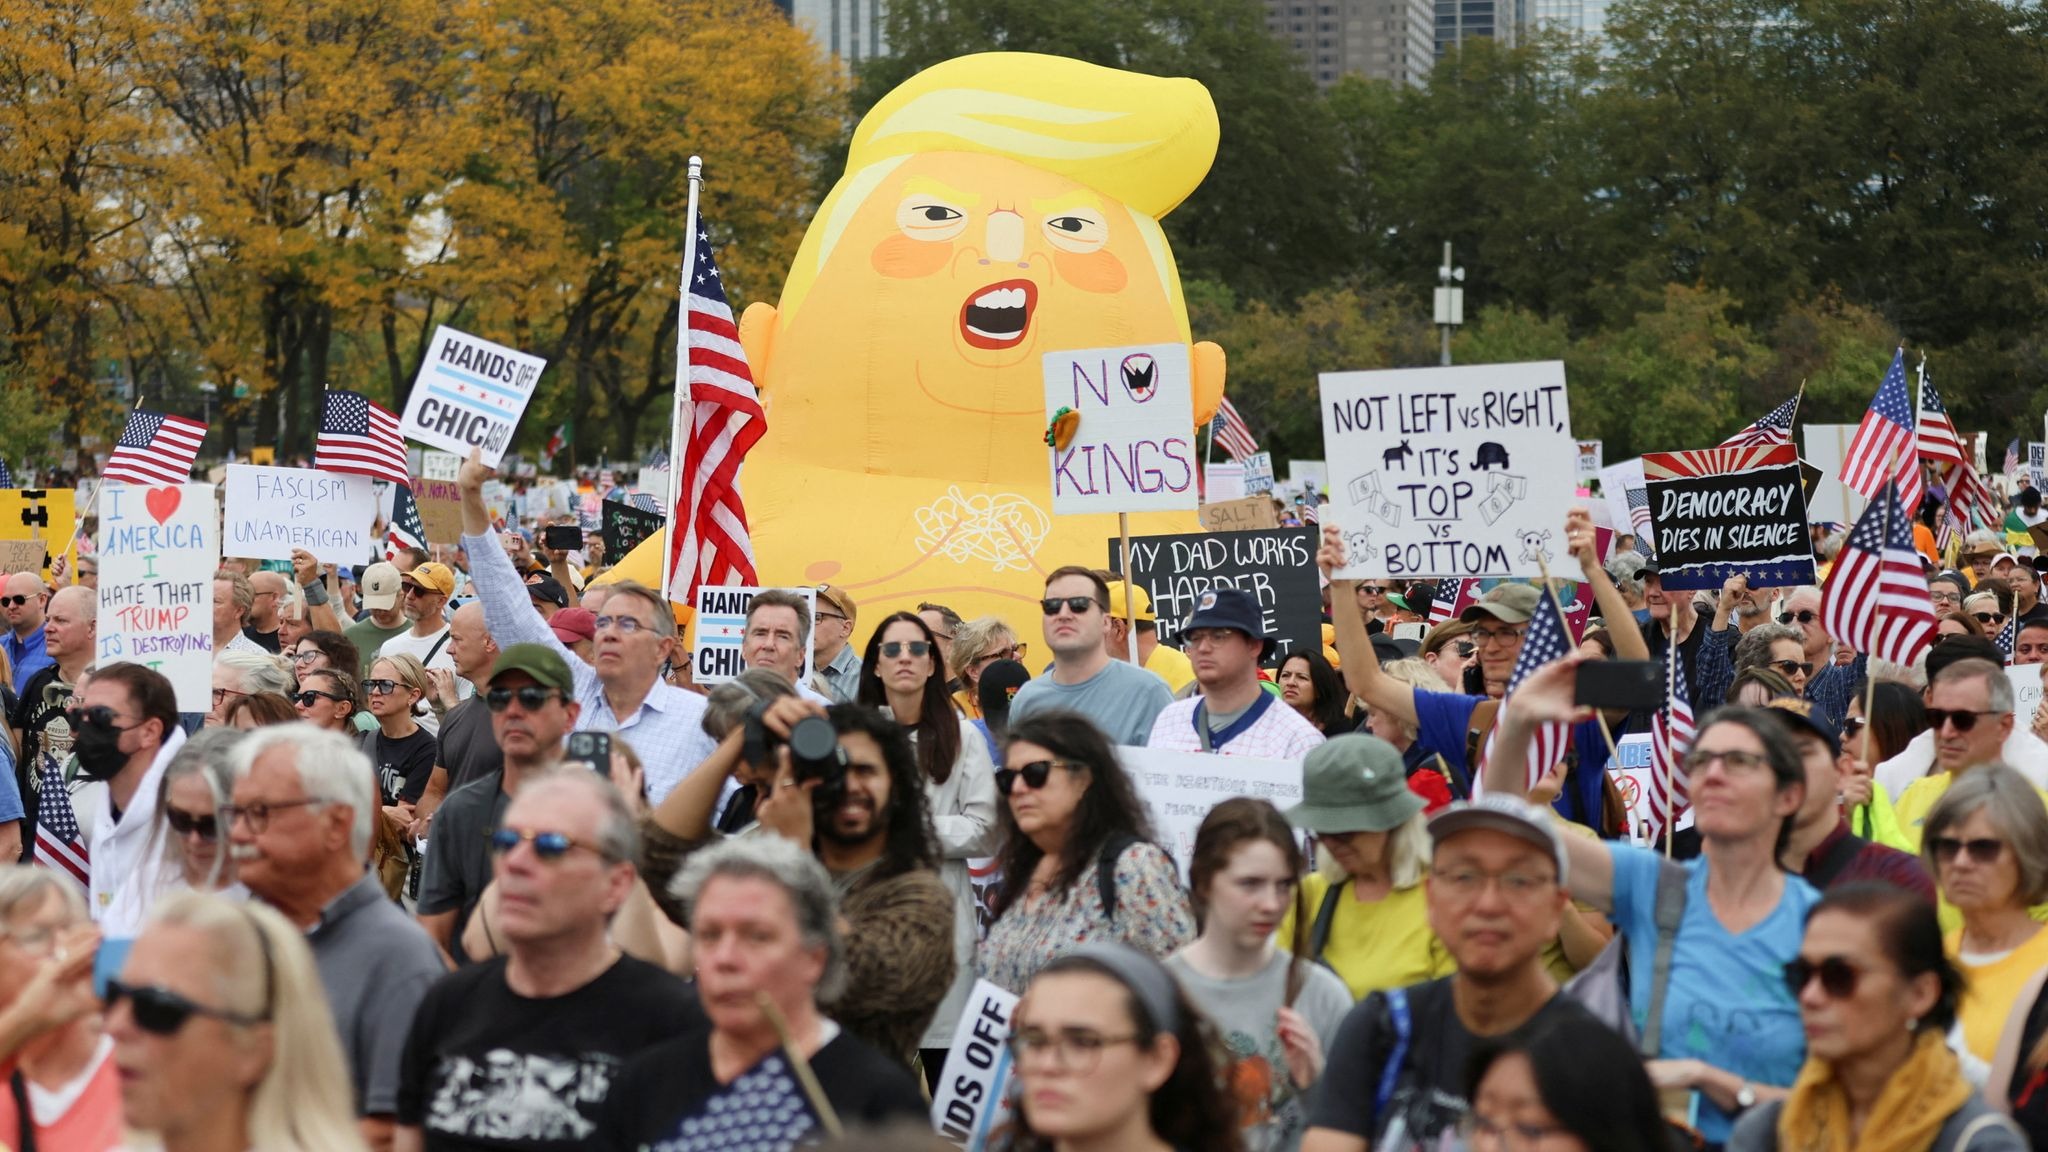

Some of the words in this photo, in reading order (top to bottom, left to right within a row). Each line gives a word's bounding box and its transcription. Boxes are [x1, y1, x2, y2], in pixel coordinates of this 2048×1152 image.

[440, 338, 516, 383] HANDS
[515, 364, 537, 389] OFF
[1333, 395, 1389, 433] NOT
[1399, 393, 1456, 433] LEFT
[1483, 386, 1563, 433] RIGHT,
[417, 398, 509, 454] CHICAGO
[1053, 437, 1191, 497] KINGS
[1419, 448, 1459, 476] IT'S
[256, 474, 347, 501] FASCISM
[1398, 481, 1473, 519] TOP
[1657, 483, 1795, 522] DEMOCRACY
[107, 489, 125, 521] I
[291, 503, 306, 519] IS
[1209, 503, 1258, 525] SALT
[102, 524, 204, 557] AMERICA
[235, 519, 358, 548] UNAMERICAN
[1661, 526, 1700, 554] DIES
[1704, 525, 1724, 550] IN
[1727, 522, 1800, 550] SILENCE
[143, 554, 160, 578] I
[1119, 541, 1160, 576] MY
[1171, 538, 1227, 574] DAD
[1234, 536, 1309, 567] WORKS
[1385, 541, 1510, 574] BOTTOM
[101, 583, 145, 609] HATE
[153, 581, 204, 606] THAT
[701, 591, 754, 615] HAND
[116, 605, 189, 633] TRUMP
[100, 633, 122, 659] IS
[132, 632, 212, 656] DESTROYING
[965, 996, 1006, 1071] OFF
